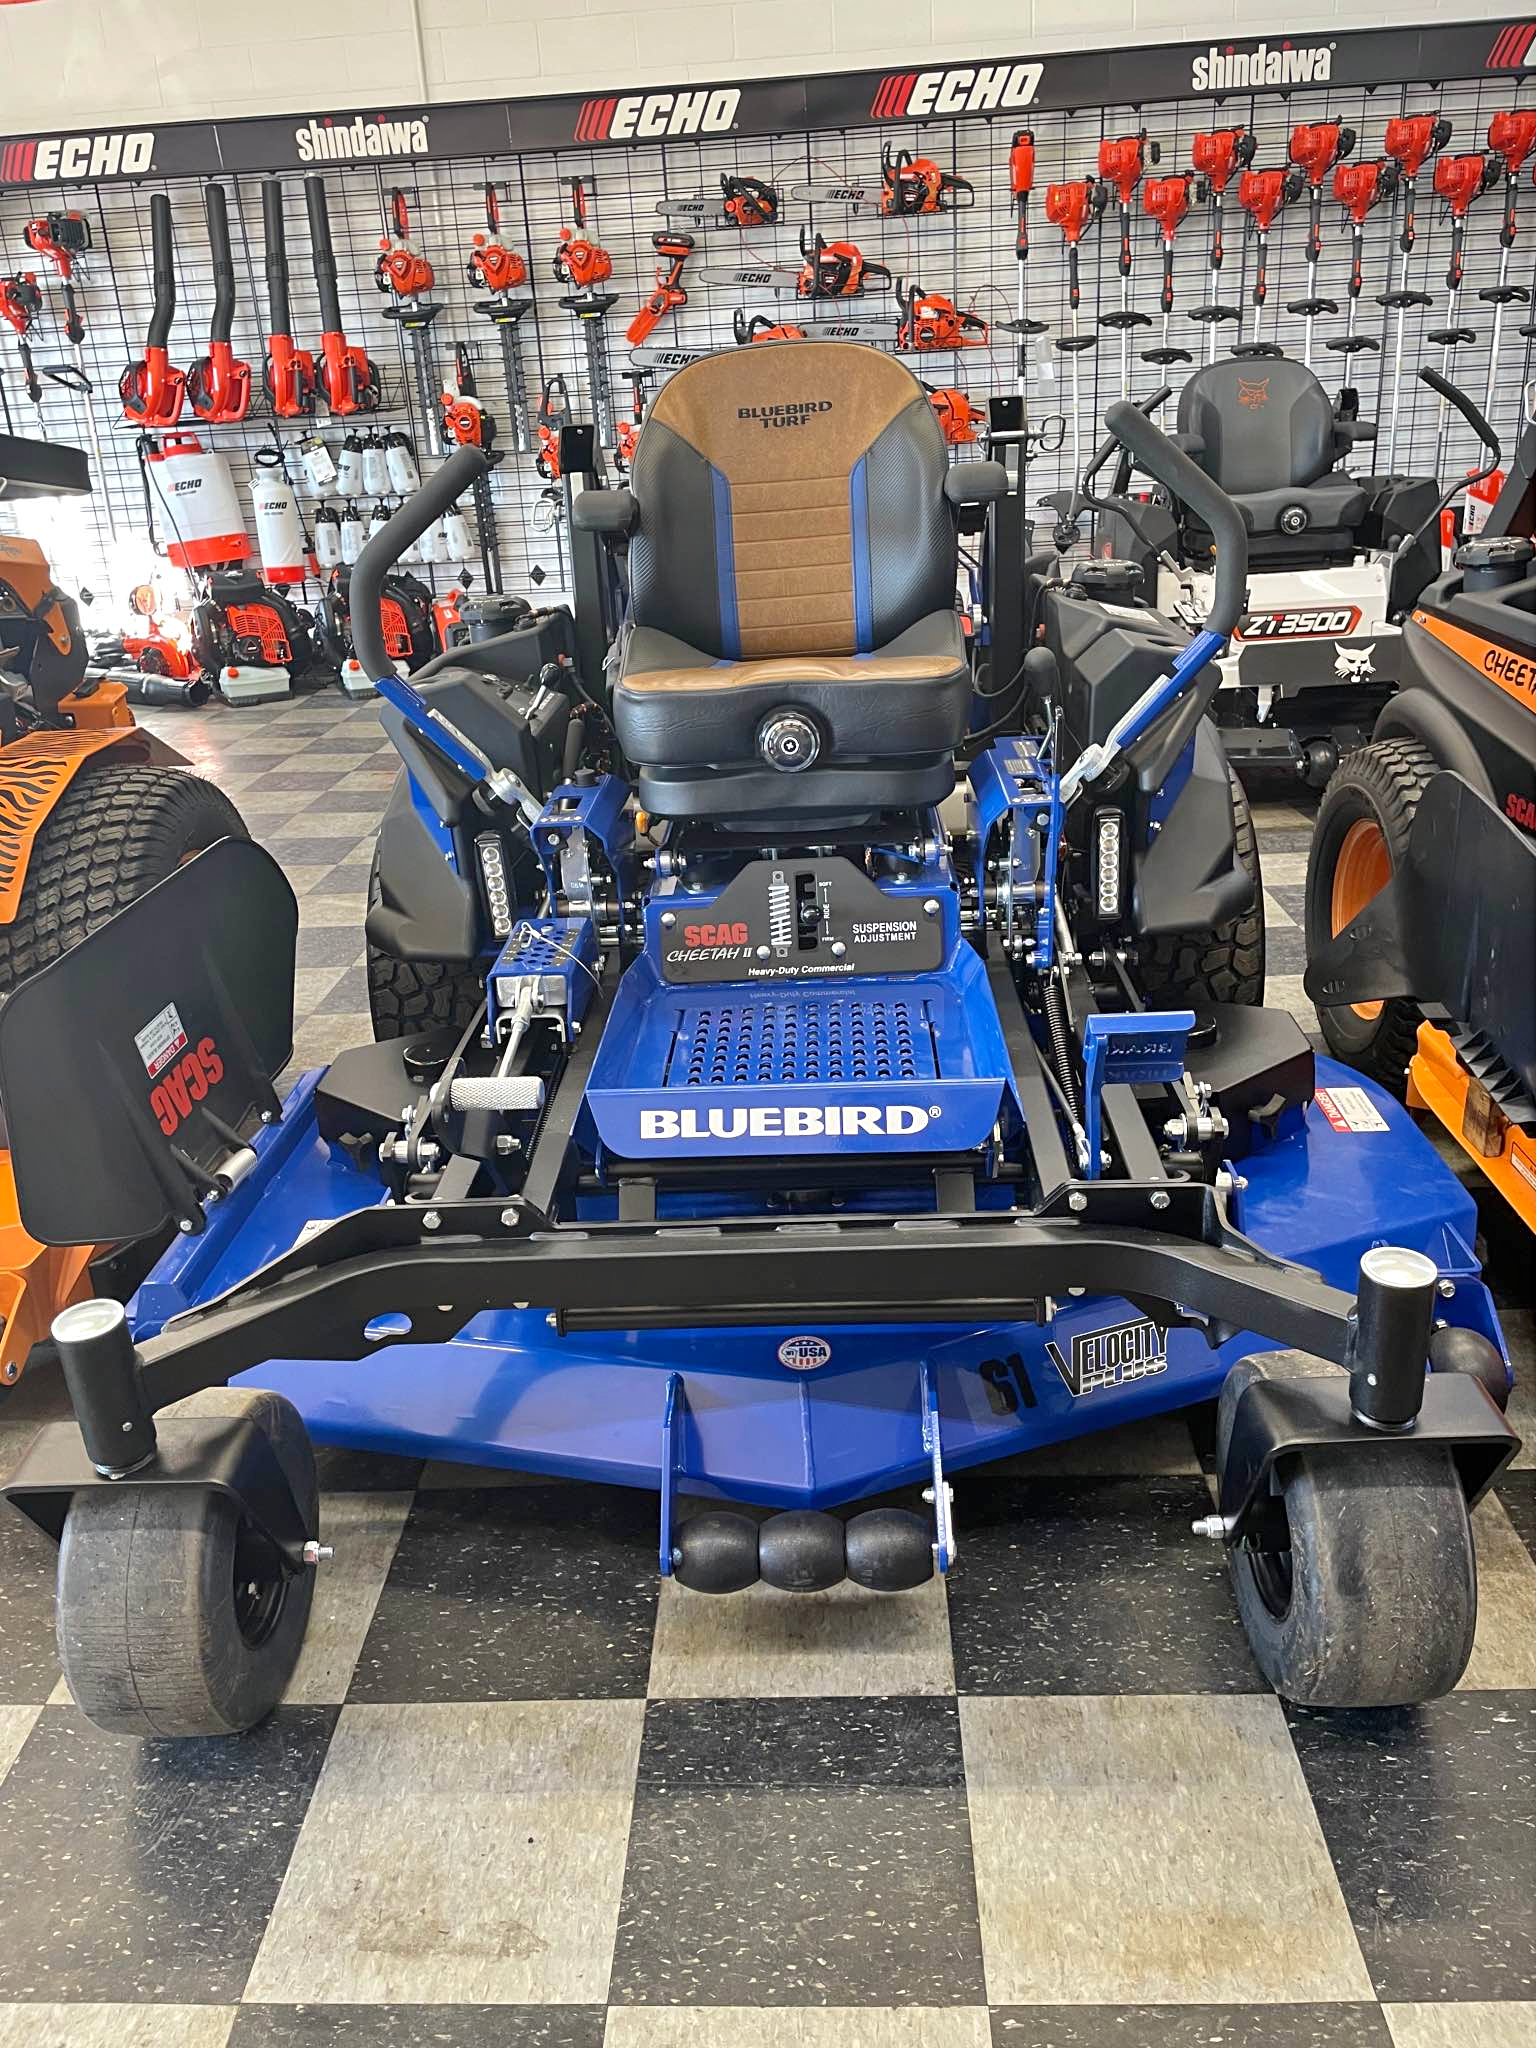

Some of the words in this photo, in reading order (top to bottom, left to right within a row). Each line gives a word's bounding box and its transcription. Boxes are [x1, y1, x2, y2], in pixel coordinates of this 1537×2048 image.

[1192, 41, 1332, 91] shindaiwa
[906, 63, 1044, 116] ECHO
[609, 88, 741, 139] ECHO
[295, 114, 429, 162] shindaiwa
[33, 132, 155, 181] ECHO
[834, 190, 865, 200] ECHO
[742, 273, 772, 284] ECHO
[830, 327, 860, 337] ECHO
[738, 401, 833, 418] BLUEBIRD
[760, 415, 811, 429] TURF
[174, 479, 203, 491] ECHO
[264, 502, 288, 510] ECHO
[1244, 610, 1352, 636] ZT3500
[822, 903, 831, 919] RIDE
[684, 922, 749, 947] SCAG
[852, 920, 917, 934] SUSPENSION
[854, 931, 917, 943] ADJUSTMENT
[666, 947, 739, 963] CHEETAH
[743, 947, 753, 958] II
[748, 966, 799, 977] Heavy-Duty
[801, 963, 855, 974] Commercial
[154, 1045, 176, 1070] DANGER
[151, 1036, 224, 1136] SCAG
[798, 1347, 827, 1358] USA
[1045, 1316, 1169, 1397] VELOCITY
[1080, 1356, 1168, 1395] PLUS
